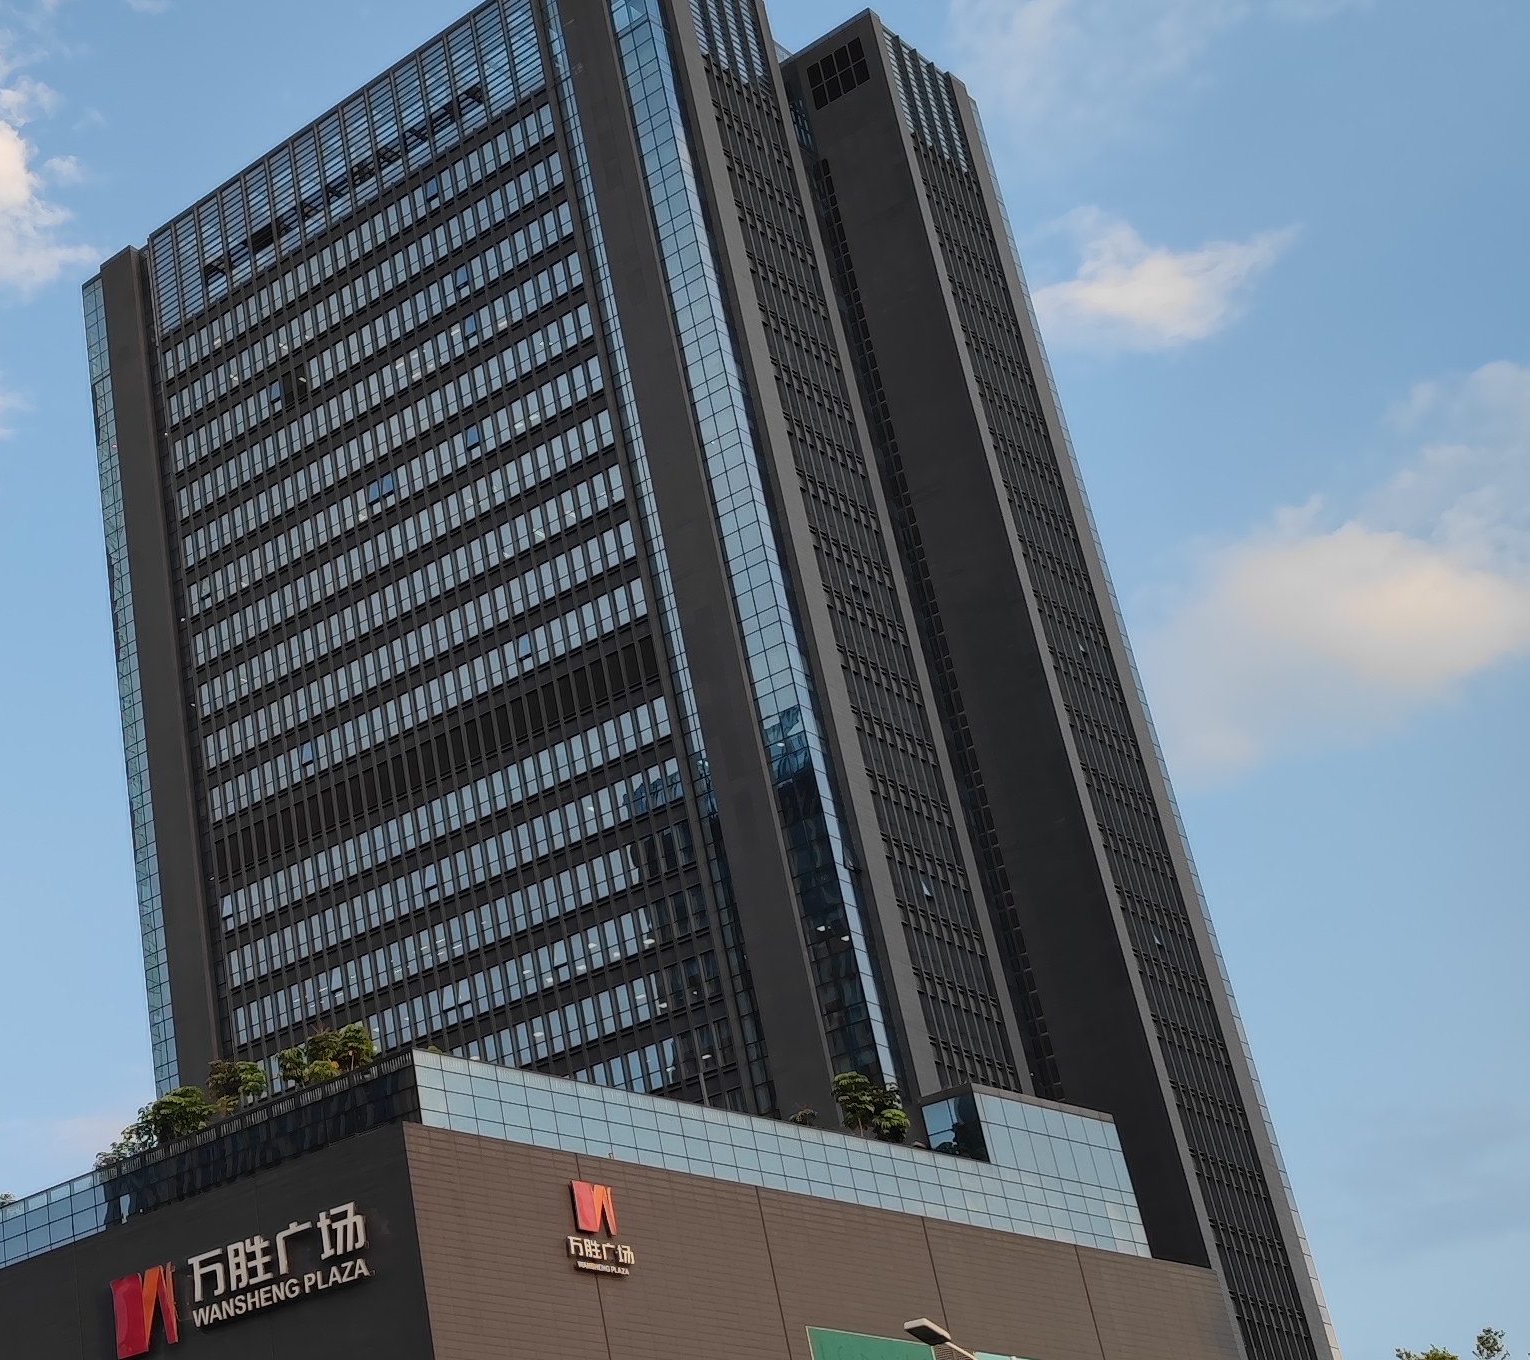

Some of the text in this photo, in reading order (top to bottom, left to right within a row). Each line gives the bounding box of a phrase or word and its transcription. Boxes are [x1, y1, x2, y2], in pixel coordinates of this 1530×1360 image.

[187, 1201, 368, 1302] 万胜广场
[567, 1236, 635, 1265] 万胜广场
[610, 1265, 630, 1276] PLAZA
[192, 1257, 371, 1327] WANSHENG PLAZA
